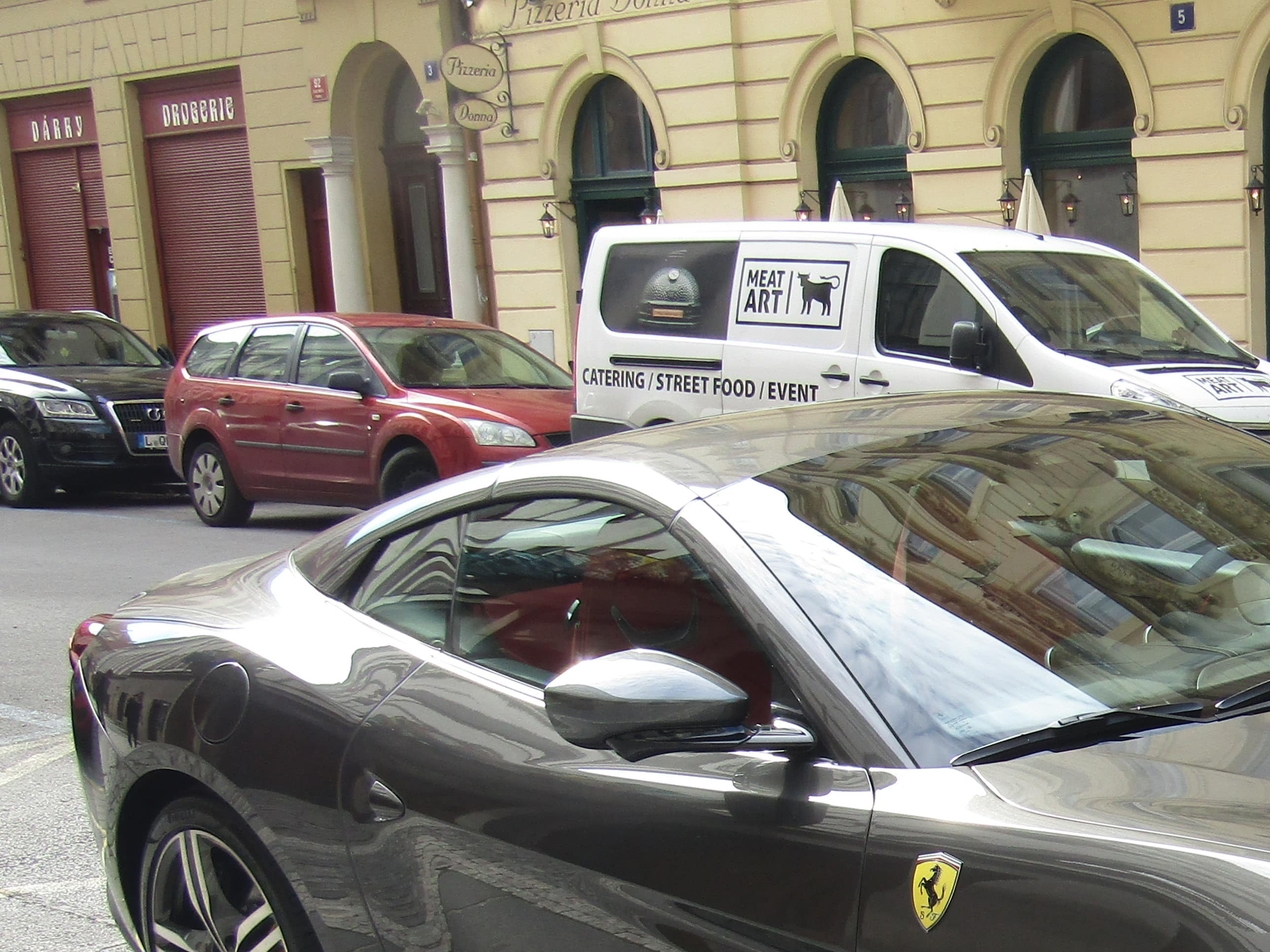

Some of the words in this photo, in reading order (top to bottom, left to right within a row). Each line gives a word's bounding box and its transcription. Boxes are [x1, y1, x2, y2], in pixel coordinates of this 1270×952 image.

[1177, 9, 1186, 25] 5
[427, 65, 434, 76] 3
[448, 56, 497, 77] Pizzeria
[313, 77, 321, 88] 92
[161, 96, 236, 127] DROGERIE
[459, 103, 495, 123] Donna
[31, 114, 84, 143] DÁRKY
[746, 269, 786, 288] MEAT
[743, 288, 784, 314] ART
[582, 367, 645, 390] CATERING
[656, 373, 709, 394] STREET
[713, 377, 756, 398] FOOD
[768, 382, 819, 402] EVENT
[1210, 383, 1244, 394] ART
